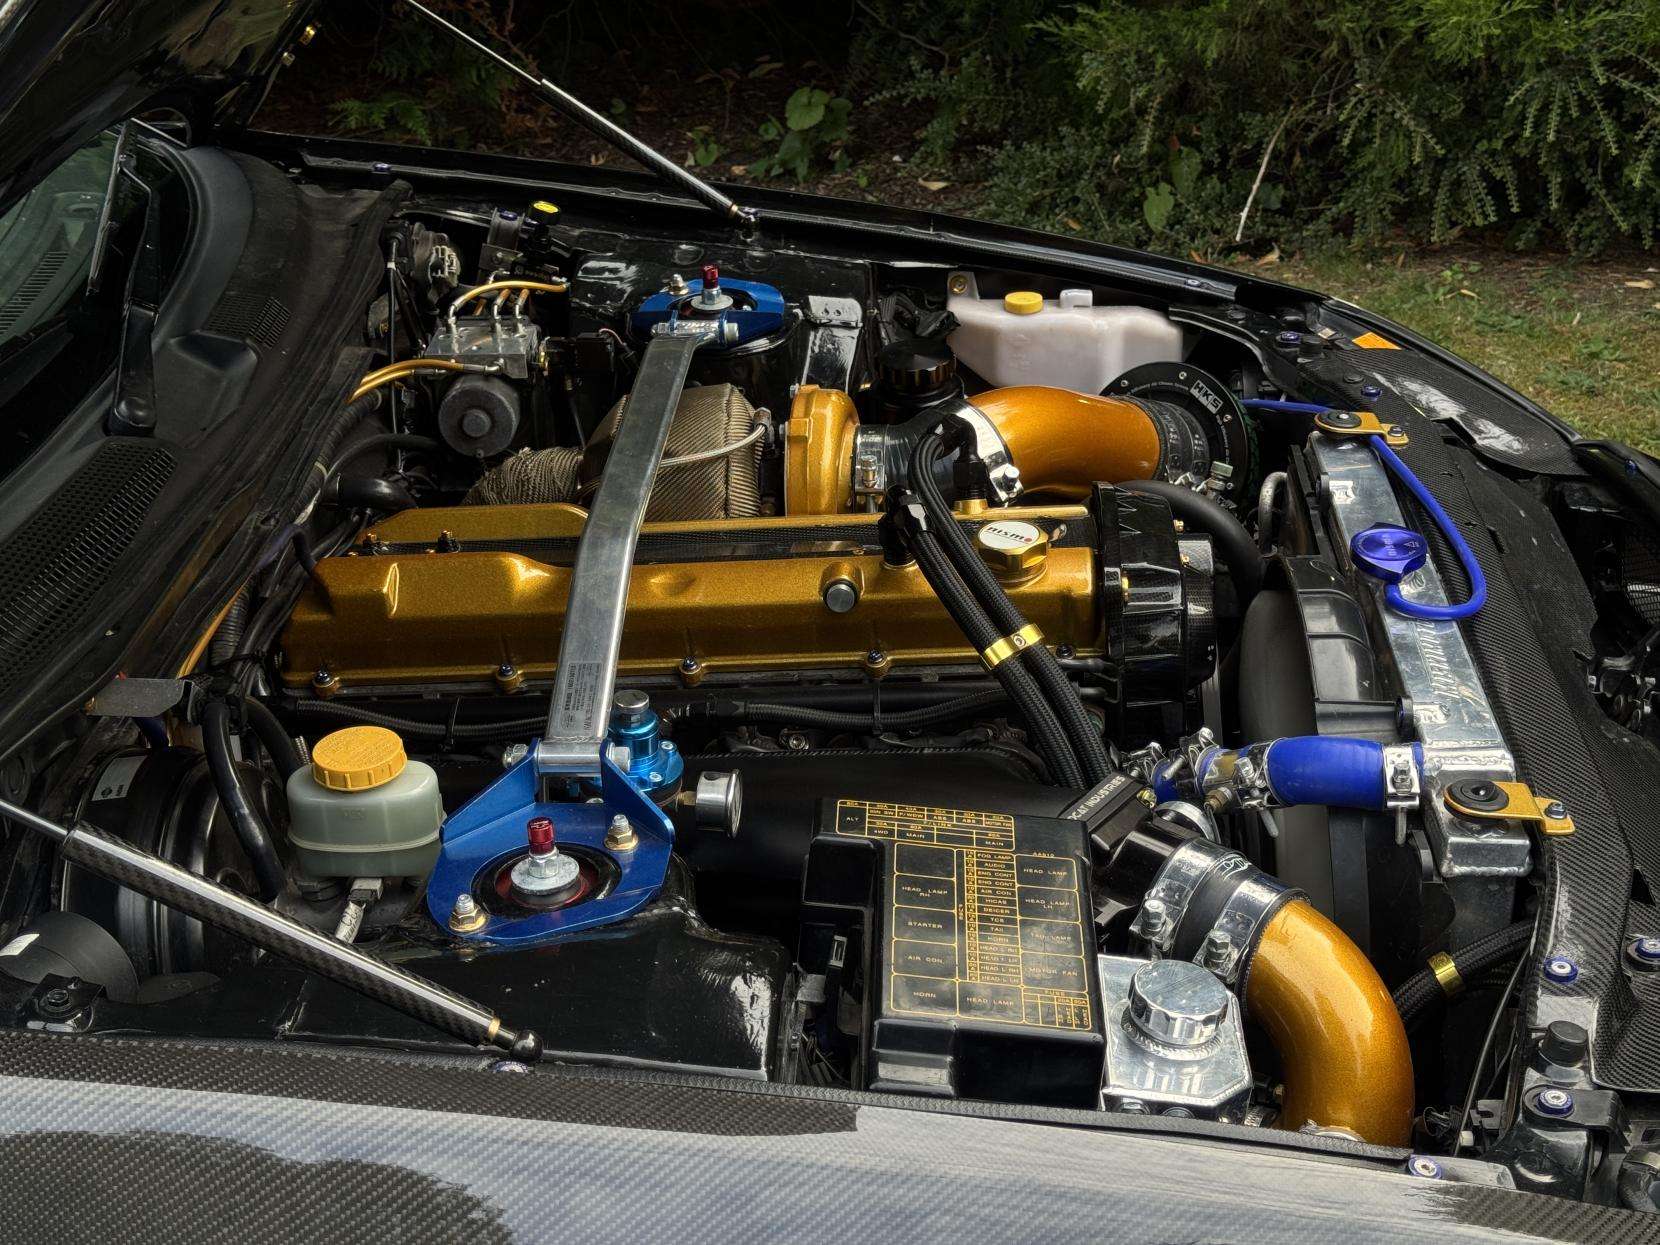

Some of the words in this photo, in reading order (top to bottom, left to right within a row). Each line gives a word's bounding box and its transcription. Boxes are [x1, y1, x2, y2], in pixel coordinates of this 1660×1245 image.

[1191, 380, 1223, 413] HKS
[986, 526, 1033, 543] nismo
[1086, 775, 1126, 808] INDUSTRIES
[908, 921, 943, 929] STARTER
